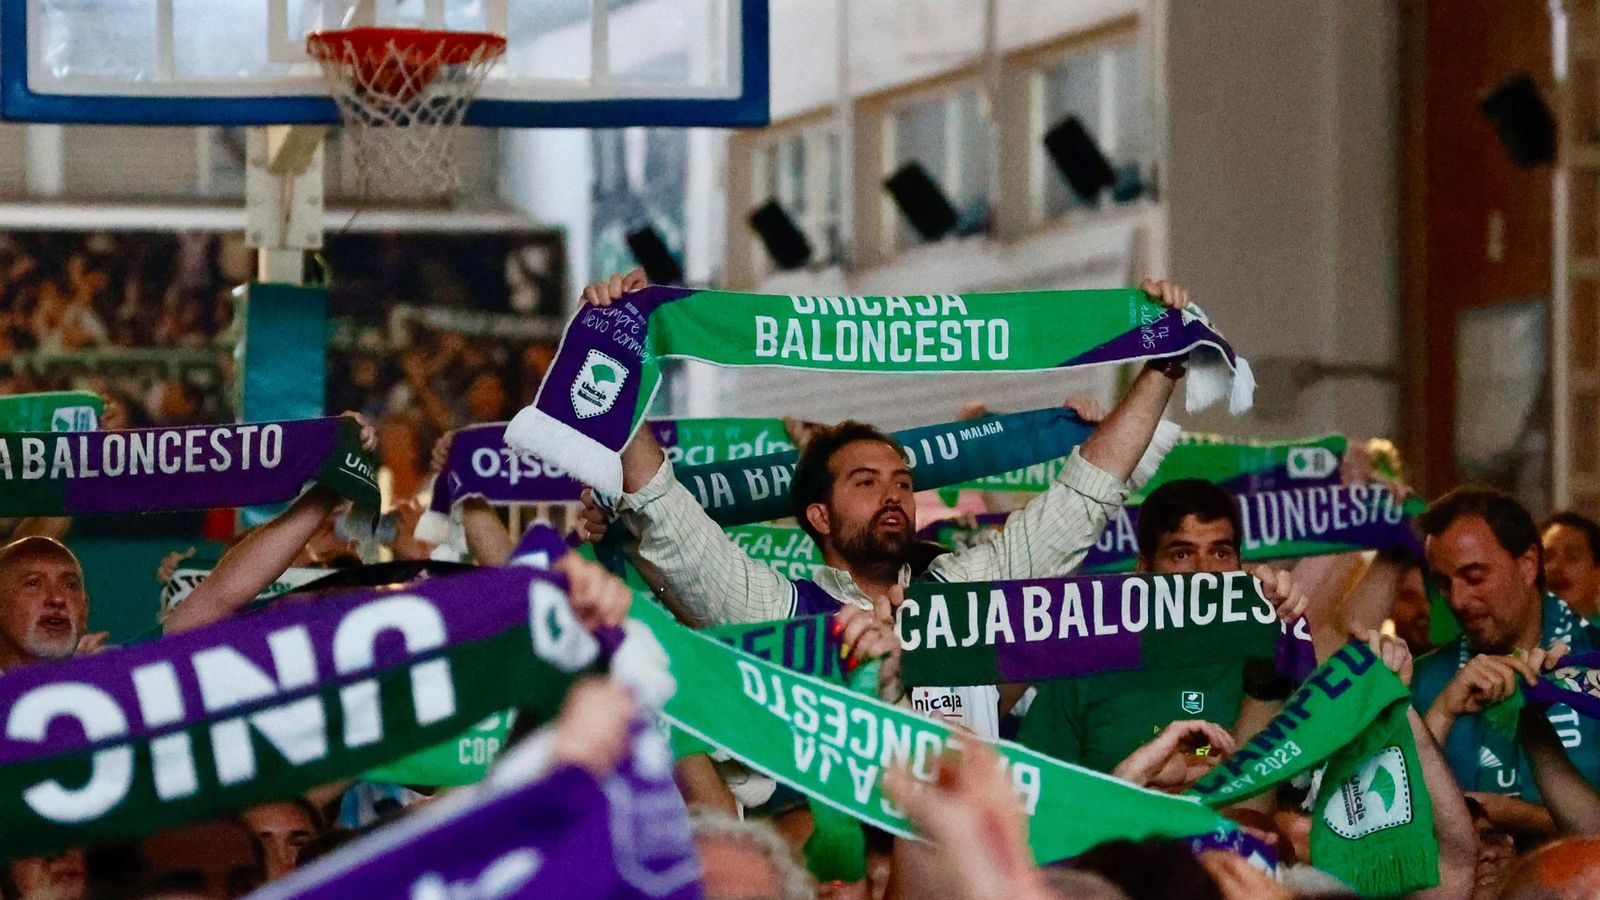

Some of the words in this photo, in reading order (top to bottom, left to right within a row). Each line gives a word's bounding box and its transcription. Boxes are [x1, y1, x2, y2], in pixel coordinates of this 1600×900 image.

[755, 315, 1009, 363] BALONCESTO
[581, 381, 607, 400] Unicaja
[960, 420, 1004, 441] MALAGA
[22, 423, 284, 480] BALONCESTO
[1254, 740, 1303, 777] 2023
